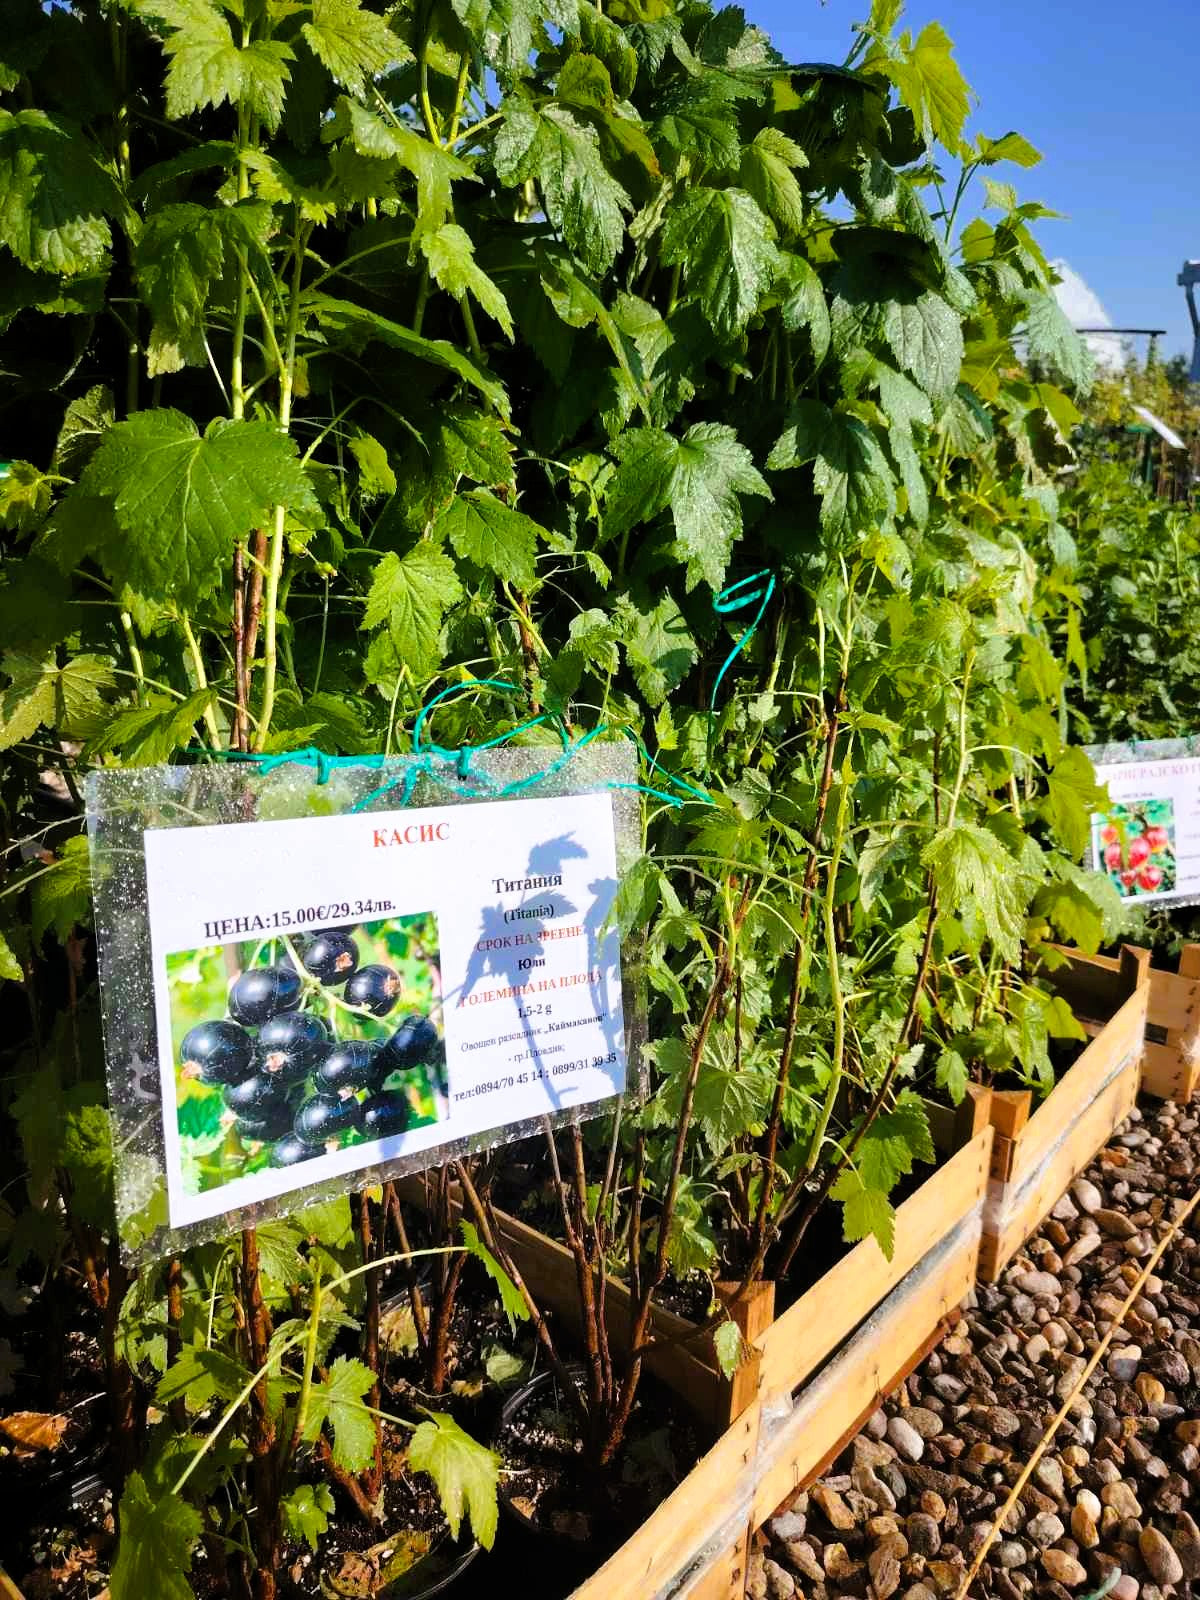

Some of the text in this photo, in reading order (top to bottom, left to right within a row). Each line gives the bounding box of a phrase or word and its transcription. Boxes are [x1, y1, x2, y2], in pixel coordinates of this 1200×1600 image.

[373, 823, 450, 847] КАСИС
[492, 874, 563, 894] Титания
[204, 898, 396, 940] ЦЕНА:15.00€/29.34лв.
[504, 903, 555, 924] (Titania)
[477, 937, 512, 952] СРОК
[515, 932, 534, 946] НА
[518, 957, 546, 971] Юли
[459, 970, 603, 1007] ГОЛЕМИНА НА ПЛОДА
[454, 1075, 514, 1102] тел:0894/70
[516, 1073, 530, 1086] 45
[531, 1069, 544, 1083] 14
[591, 1055, 604, 1069] 39
[605, 1052, 618, 1065] 35
